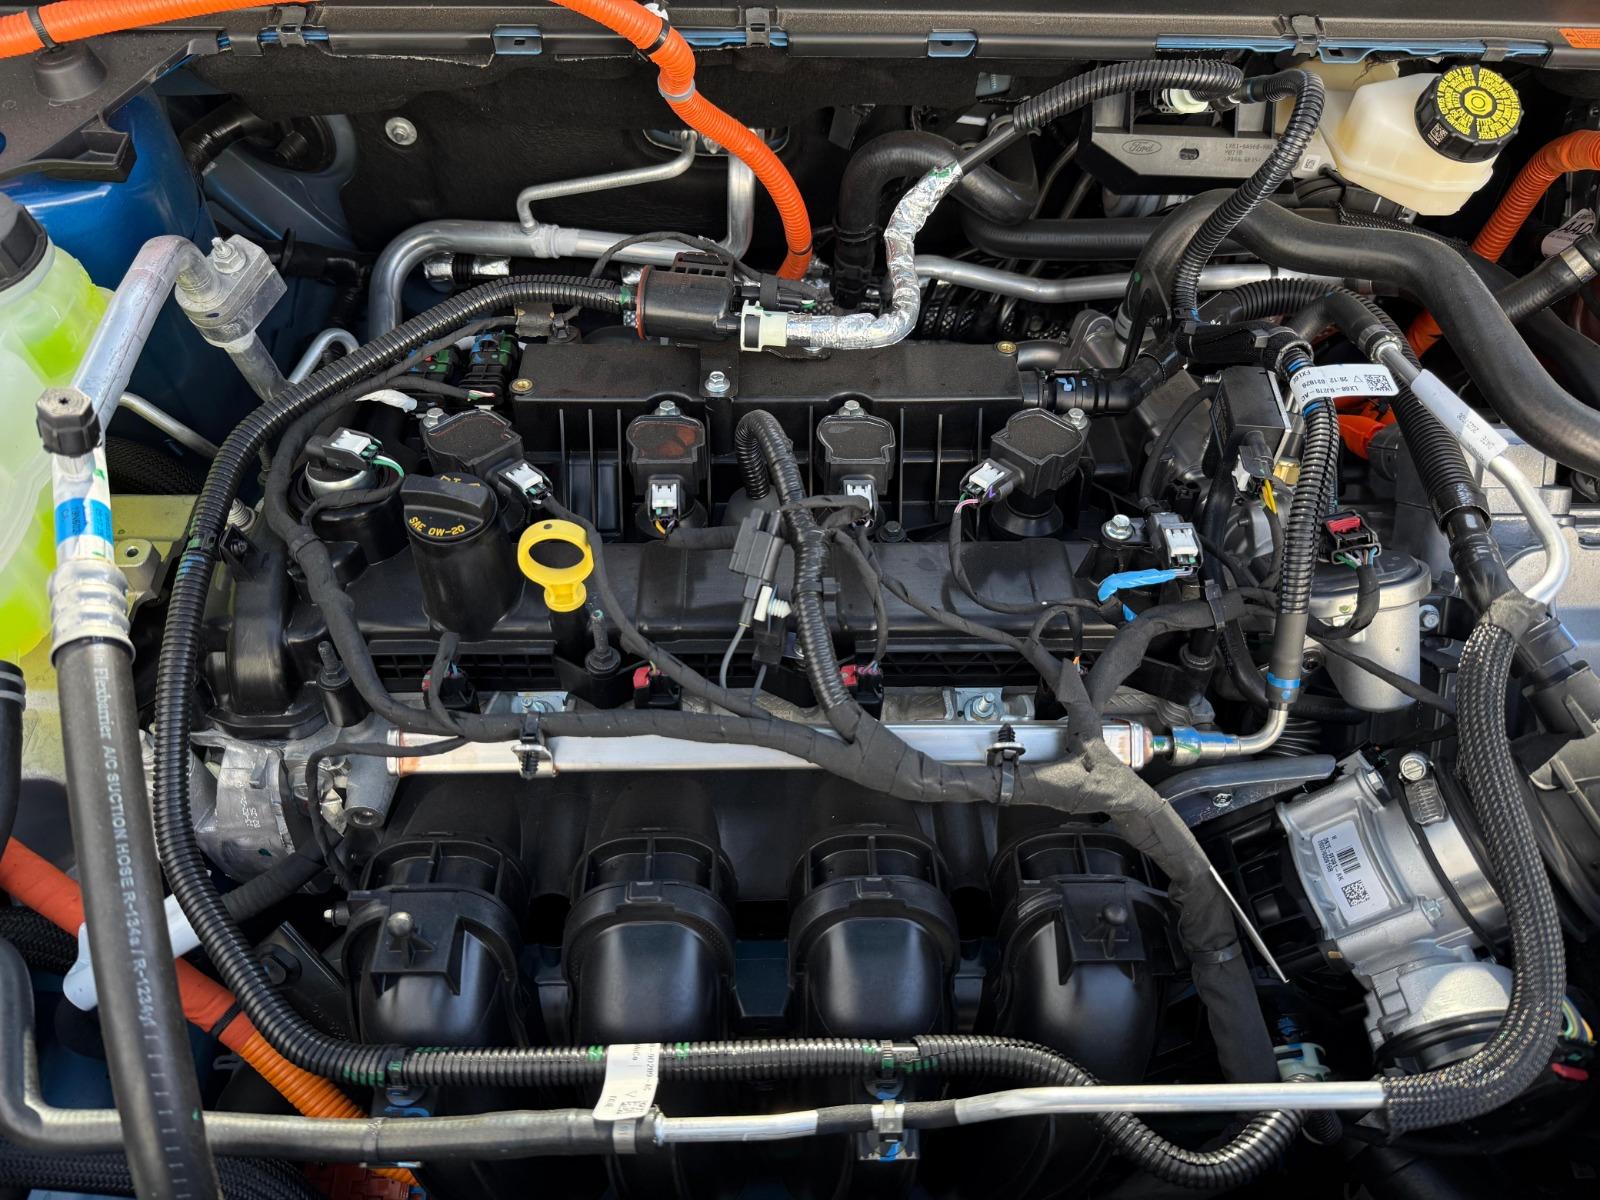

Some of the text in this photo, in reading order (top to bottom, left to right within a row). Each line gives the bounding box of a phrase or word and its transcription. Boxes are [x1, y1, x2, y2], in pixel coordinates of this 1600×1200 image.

[408, 516, 426, 532] SAE
[102, 746, 116, 772] A/C
[107, 774, 127, 840] SUCTION
[115, 843, 134, 887] HOSE
